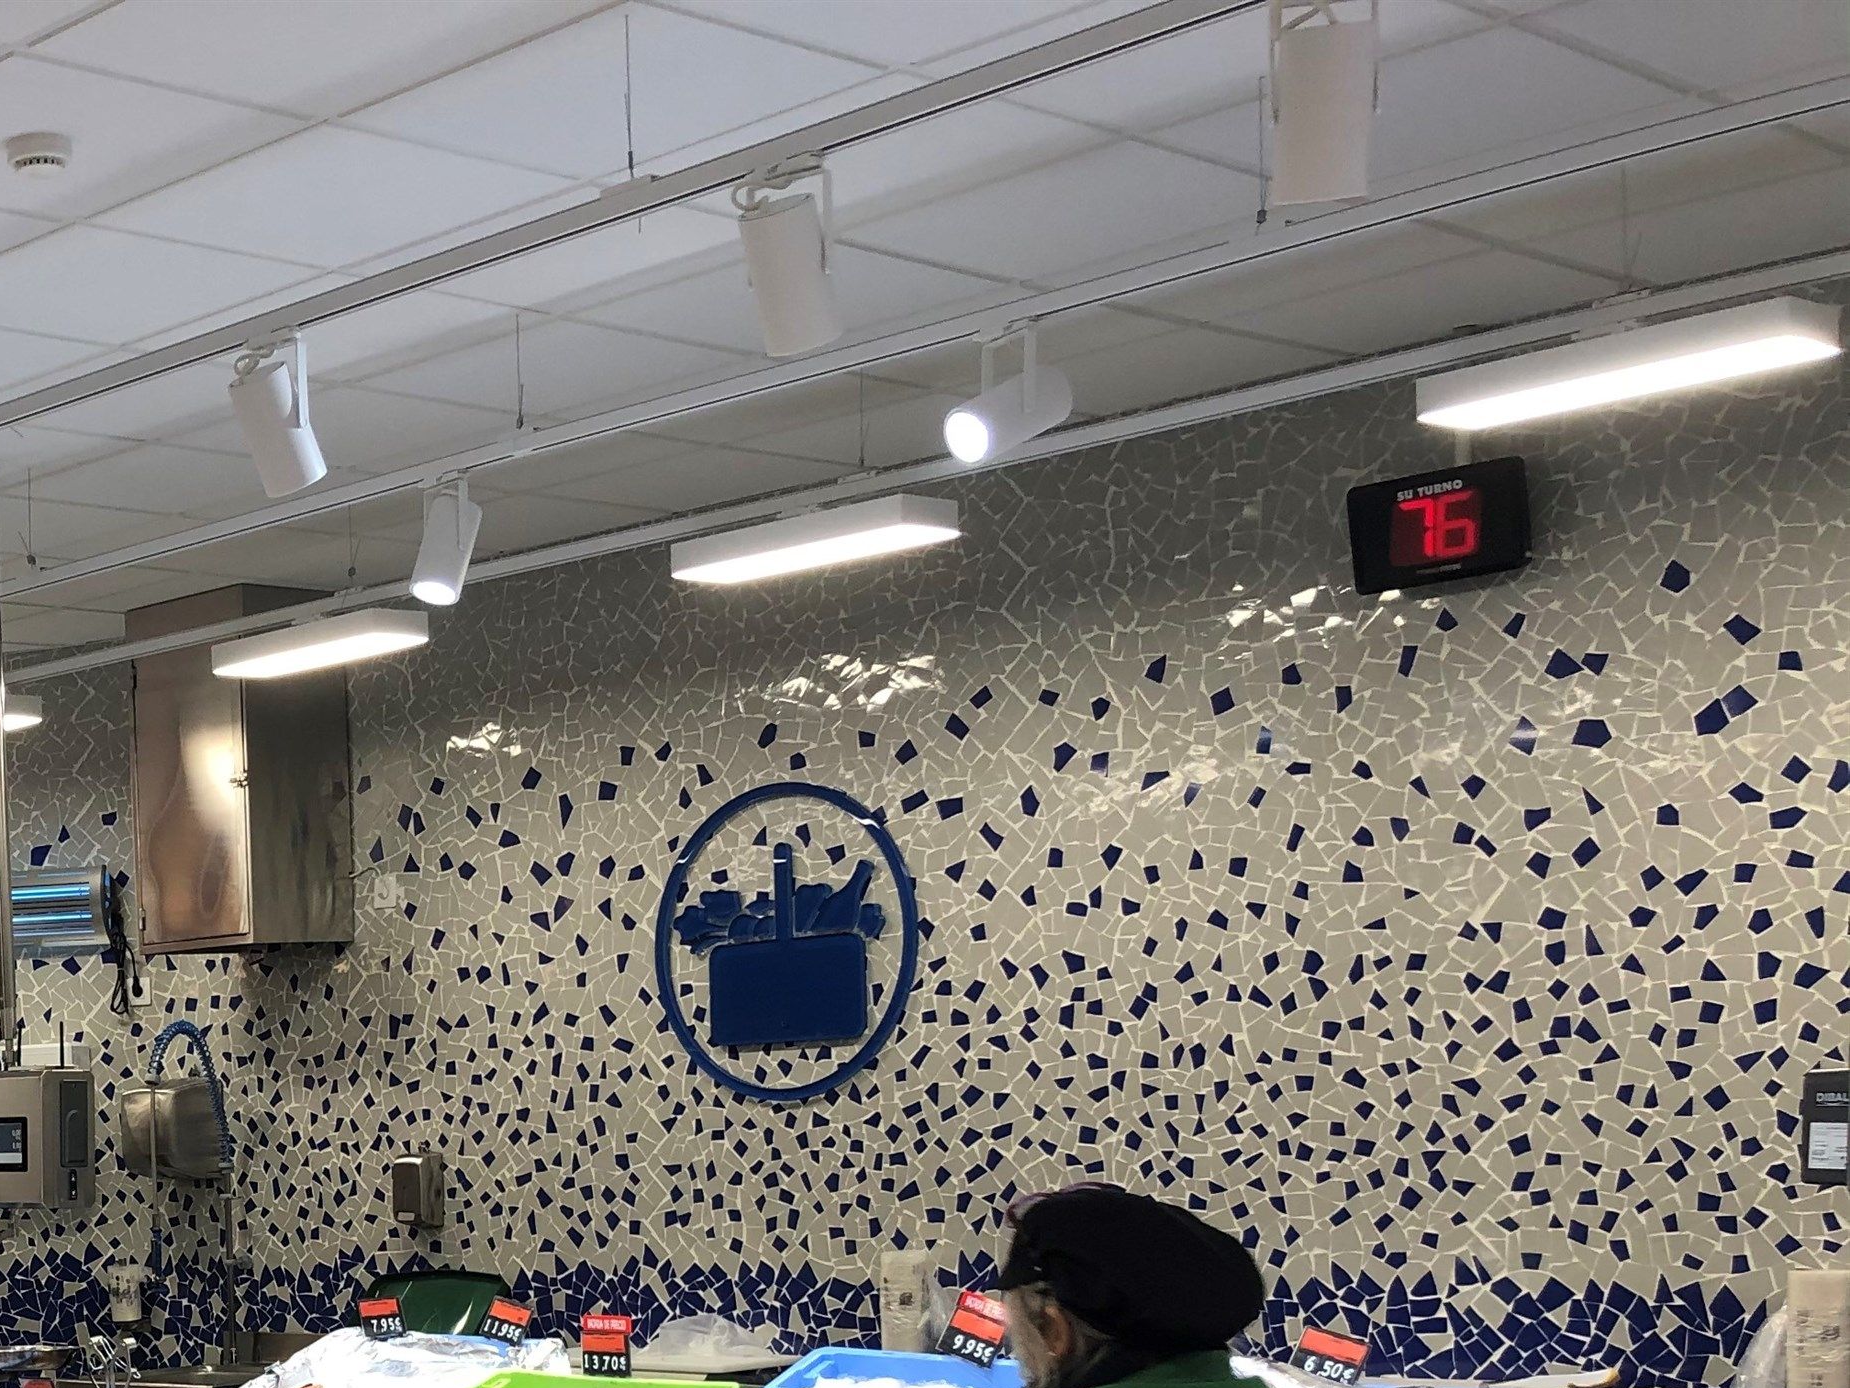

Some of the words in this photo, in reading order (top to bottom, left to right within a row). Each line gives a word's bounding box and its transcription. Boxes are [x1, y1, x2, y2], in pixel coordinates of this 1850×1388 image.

[1396, 490, 1414, 501] SU
[1417, 479, 1463, 498] TURNO
[1398, 489, 1479, 558] 76
